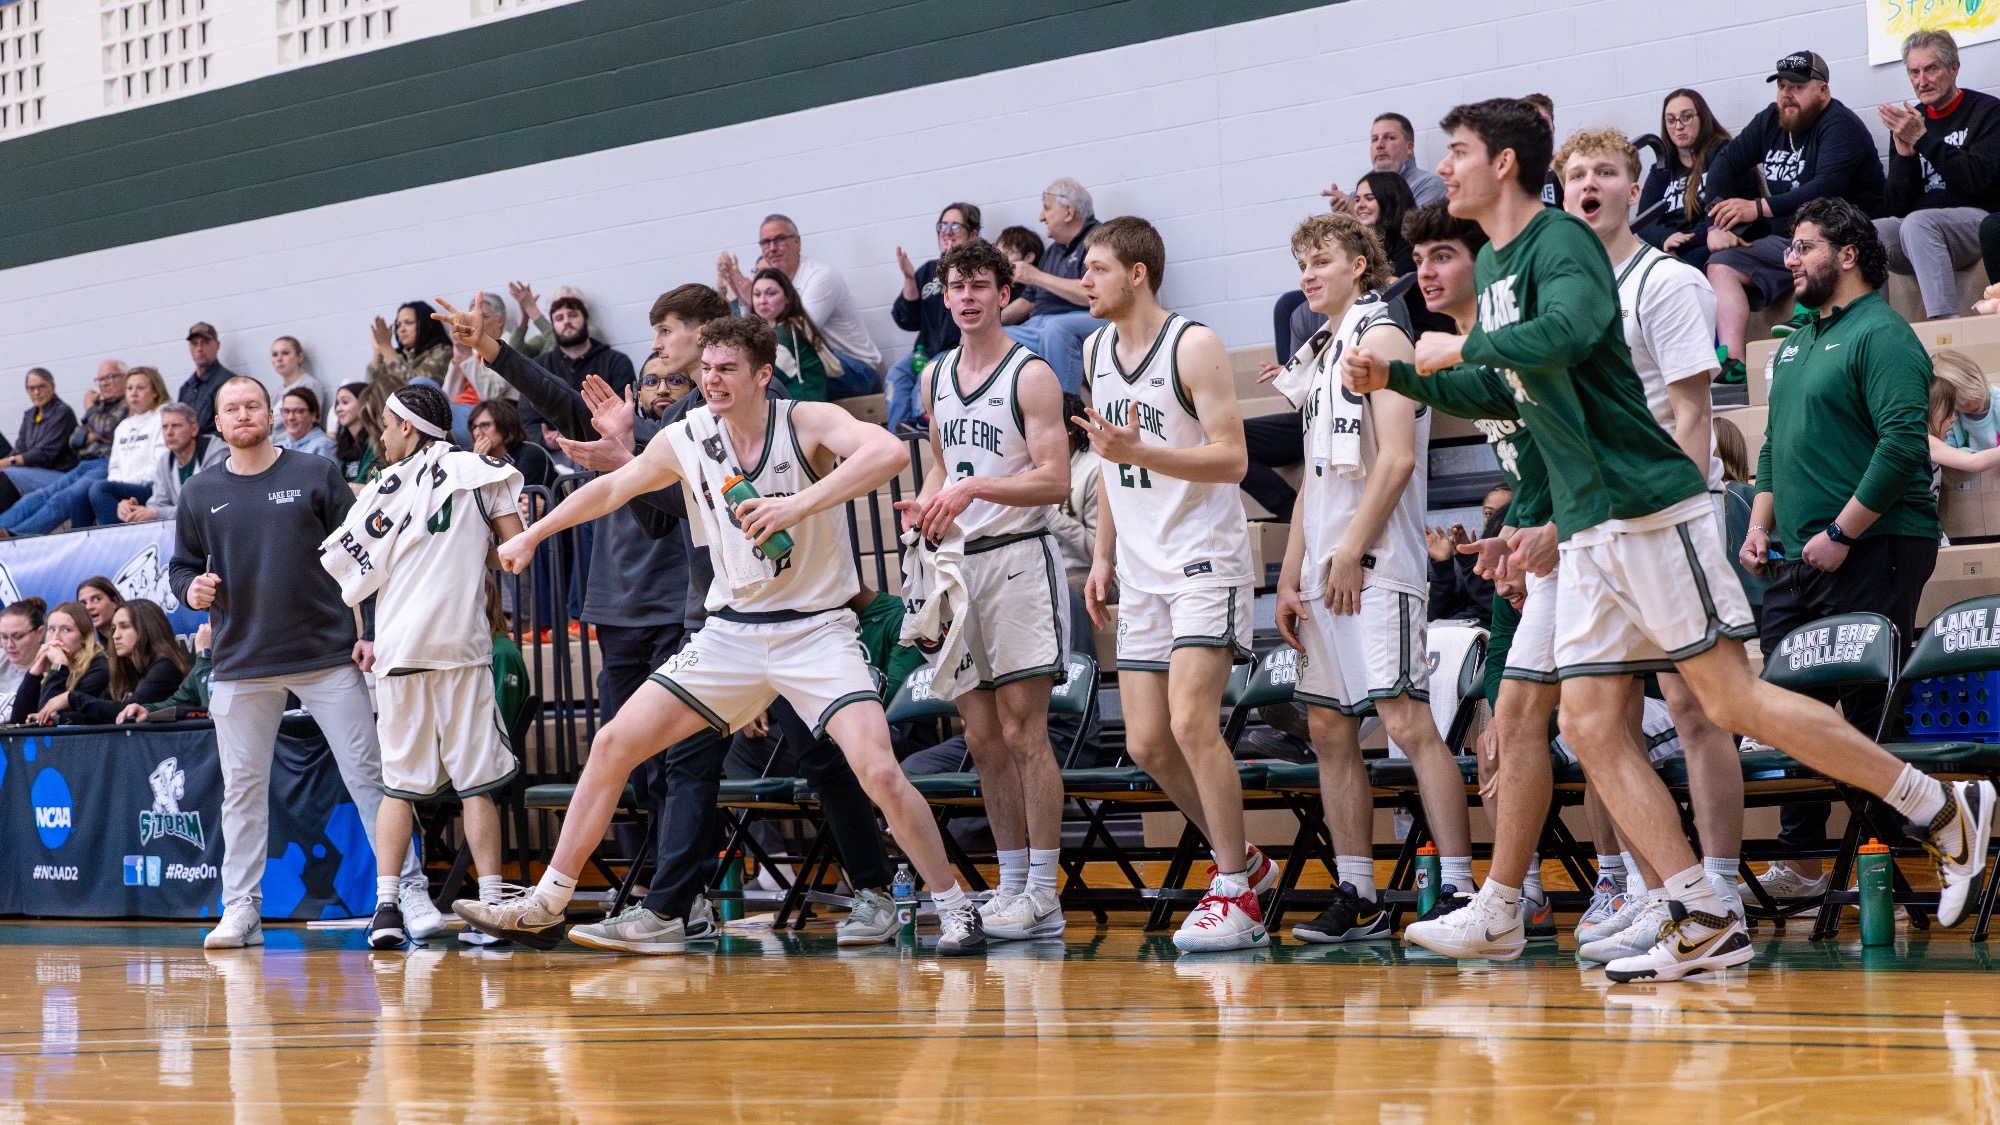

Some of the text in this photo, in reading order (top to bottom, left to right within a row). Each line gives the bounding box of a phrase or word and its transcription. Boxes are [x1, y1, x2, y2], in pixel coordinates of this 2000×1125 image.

[939, 418, 1004, 458] AKE ERIE
[268, 491, 285, 501] LAKE
[286, 489, 302, 498] ERIE
[1935, 609, 1988, 637] LAKE
[1781, 624, 1881, 657] LAKE ERIE
[1943, 627, 2000, 654] COLLE
[1264, 650, 1297, 671] LAK
[1789, 643, 1866, 671] COLLEGE
[906, 667, 936, 689] LAK
[36, 807, 71, 828] NCAA
[139, 809, 206, 851] STORM
[32, 864, 79, 881] #NCAAD2
[165, 863, 218, 883] #RageOn
